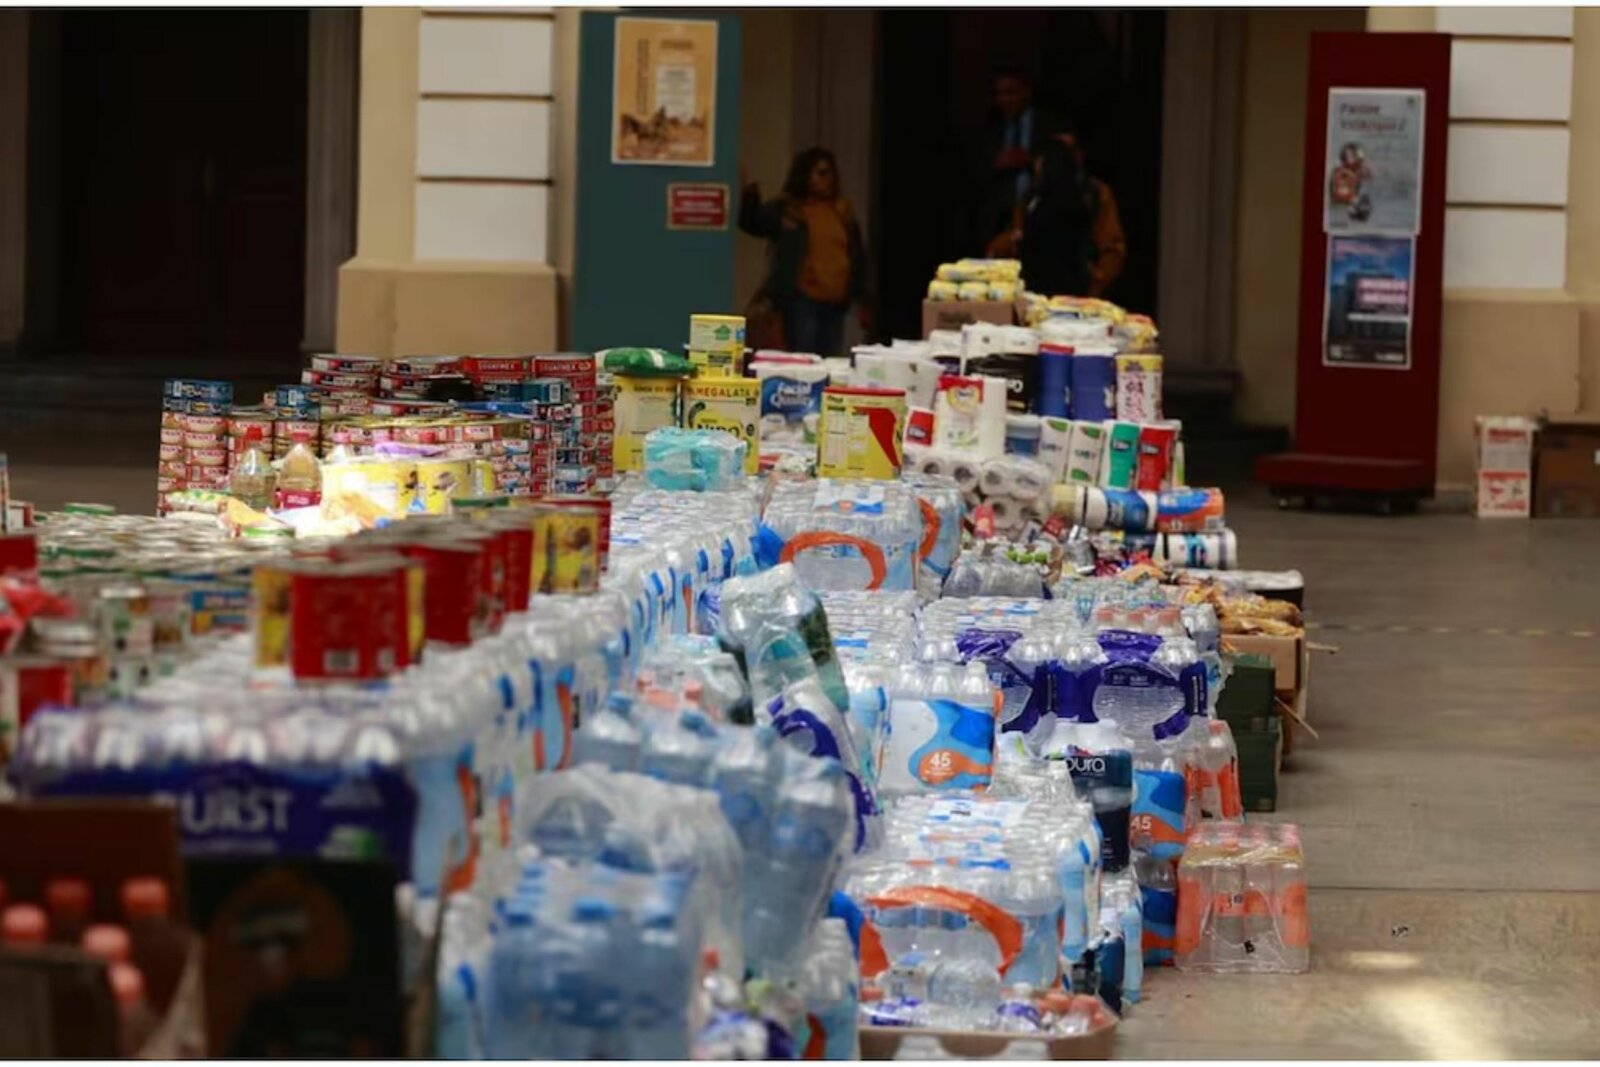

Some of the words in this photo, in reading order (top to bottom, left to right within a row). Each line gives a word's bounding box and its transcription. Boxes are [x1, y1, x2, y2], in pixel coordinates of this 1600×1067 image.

[697, 387, 750, 397] MEGALATA
[930, 752, 952, 767] 45
[163, 788, 293, 833] URST
[1131, 816, 1152, 830] 45
